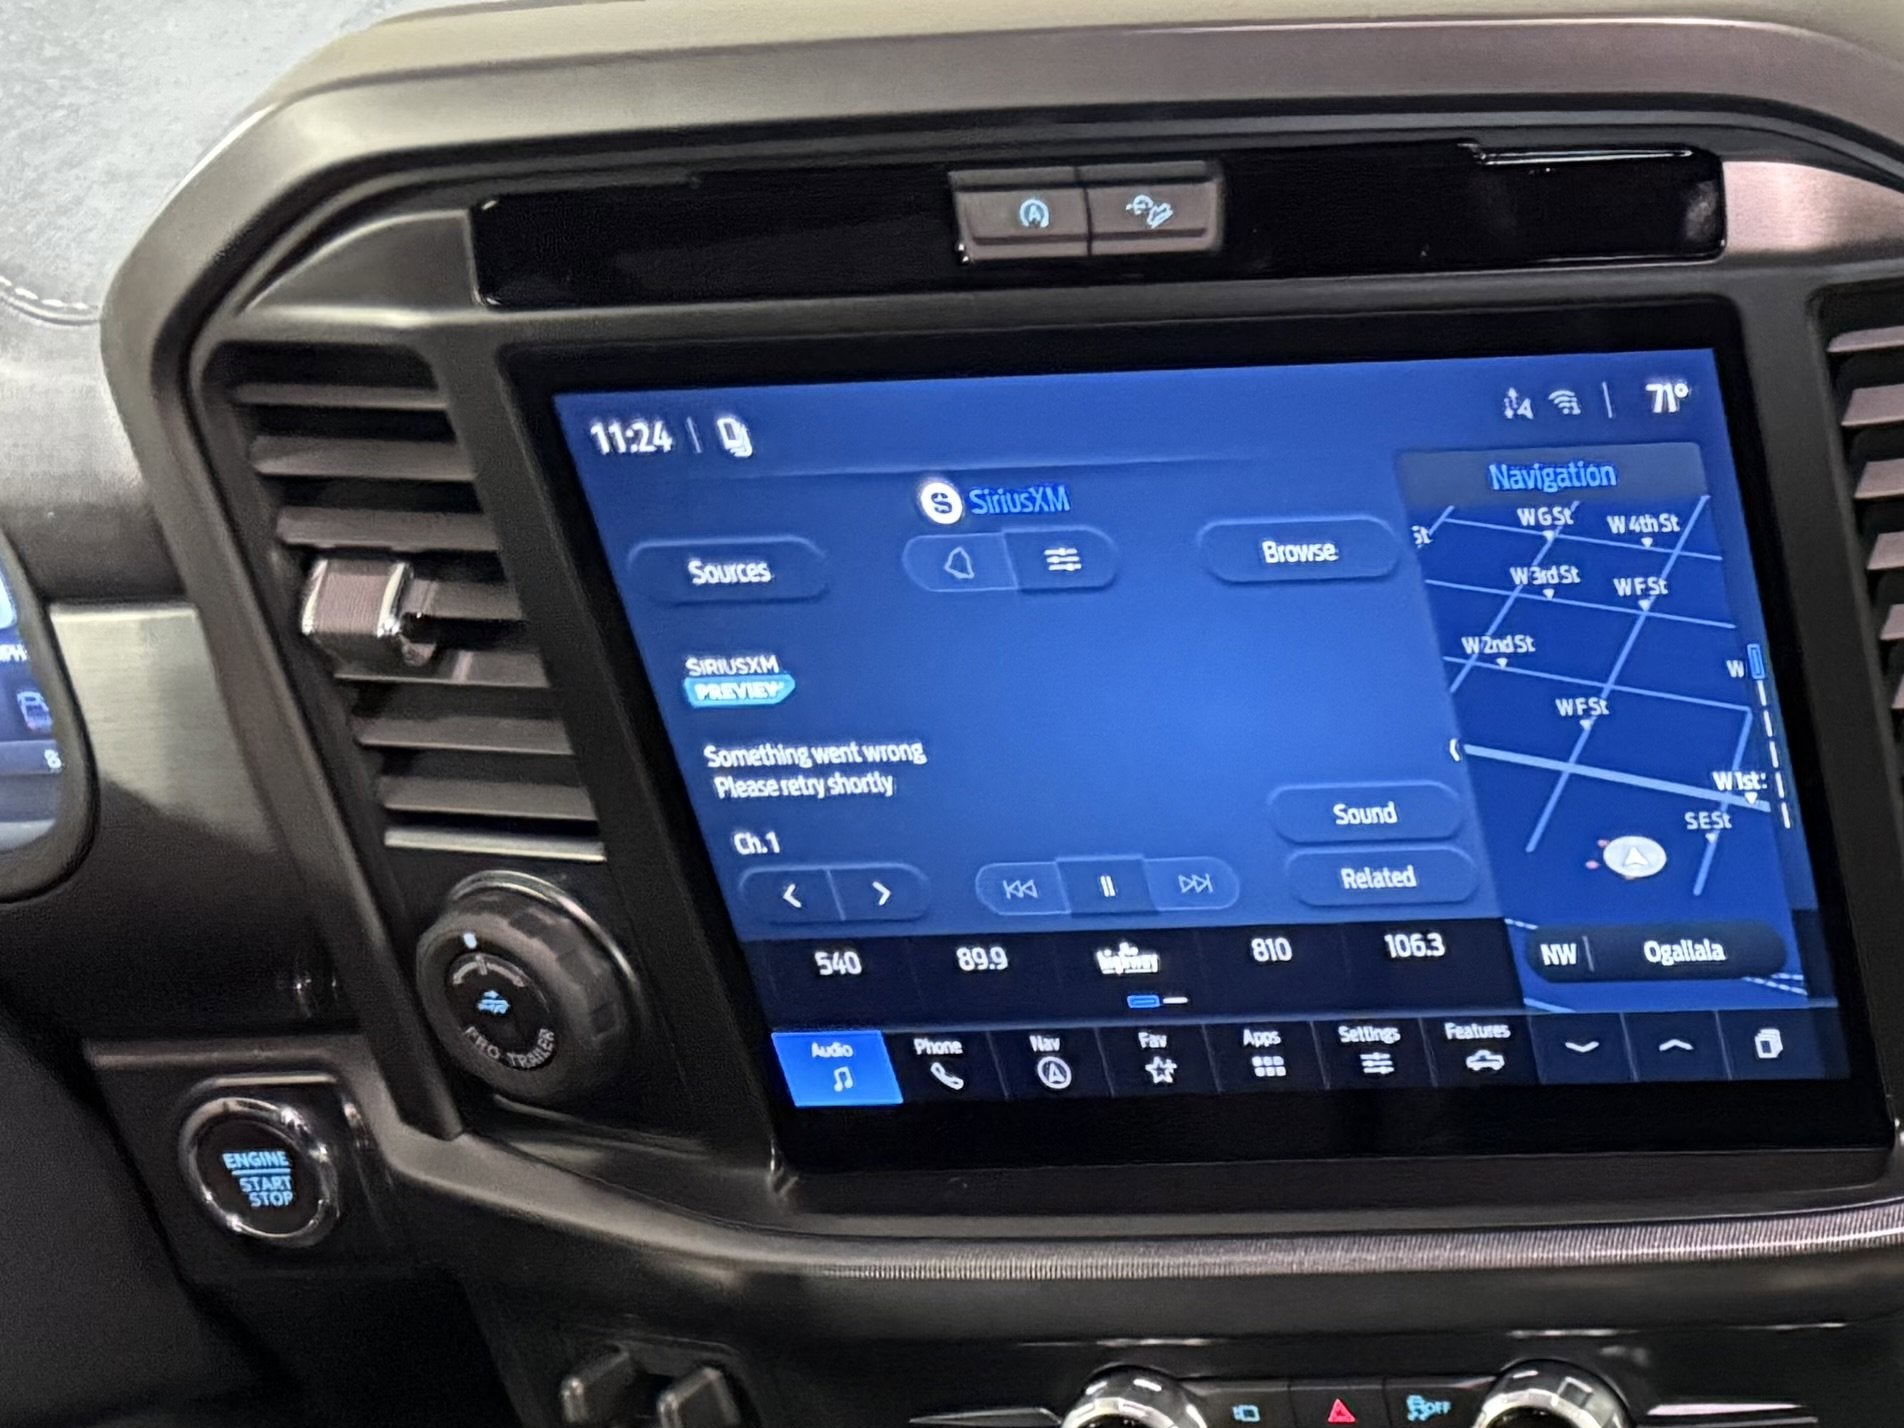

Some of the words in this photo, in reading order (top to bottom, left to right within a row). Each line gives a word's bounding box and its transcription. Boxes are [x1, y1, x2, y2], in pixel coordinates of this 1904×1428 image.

[590, 421, 672, 453] 11:24
[1489, 461, 1617, 494] Navigation
[968, 485, 1070, 514] SiriusXM
[1517, 507, 1537, 526] W
[1551, 506, 1574, 525] St
[1607, 515, 1628, 534] W
[1629, 514, 1658, 533] 4th
[1660, 514, 1680, 532] St
[1262, 540, 1339, 564] Browse
[687, 559, 772, 584] Sources
[1510, 566, 1529, 585] W
[1530, 565, 1560, 584] 3rd
[1561, 564, 1581, 583] St
[1613, 578, 1633, 597] W
[1647, 576, 1669, 595] St
[1461, 636, 1480, 654] W
[1483, 634, 1513, 654] 2nd
[1516, 634, 1536, 653] St
[686, 655, 779, 676] SIRIUSXM
[1556, 698, 1573, 717] W
[1587, 697, 1610, 715] St
[704, 743, 812, 769] Something
[811, 741, 862, 765] went
[861, 741, 928, 765] wrong
[714, 776, 780, 799] Please
[780, 776, 826, 799] retry
[828, 771, 893, 797] shortly
[1712, 771, 1733, 791] W
[1333, 802, 1398, 826] Sound
[1340, 866, 1417, 891] Related
[1251, 937, 1293, 963] 810
[1384, 933, 1445, 959] 106.3
[1540, 942, 1578, 967] NW
[1644, 940, 1726, 964] Ogallala
[814, 951, 863, 976] 540
[956, 946, 1009, 971] 89.9
[1139, 1031, 1168, 1049] Fav
[1243, 1027, 1281, 1048] Apps
[1338, 1024, 1400, 1046] Settings
[1444, 1021, 1511, 1041] Features
[811, 1041, 853, 1059] Audio
[914, 1037, 963, 1056] Phone
[1030, 1034, 1060, 1052] Nav
[222, 1151, 291, 1169] ENGINE
[239, 1175, 292, 1192] START
[248, 1191, 293, 1208] STOP
